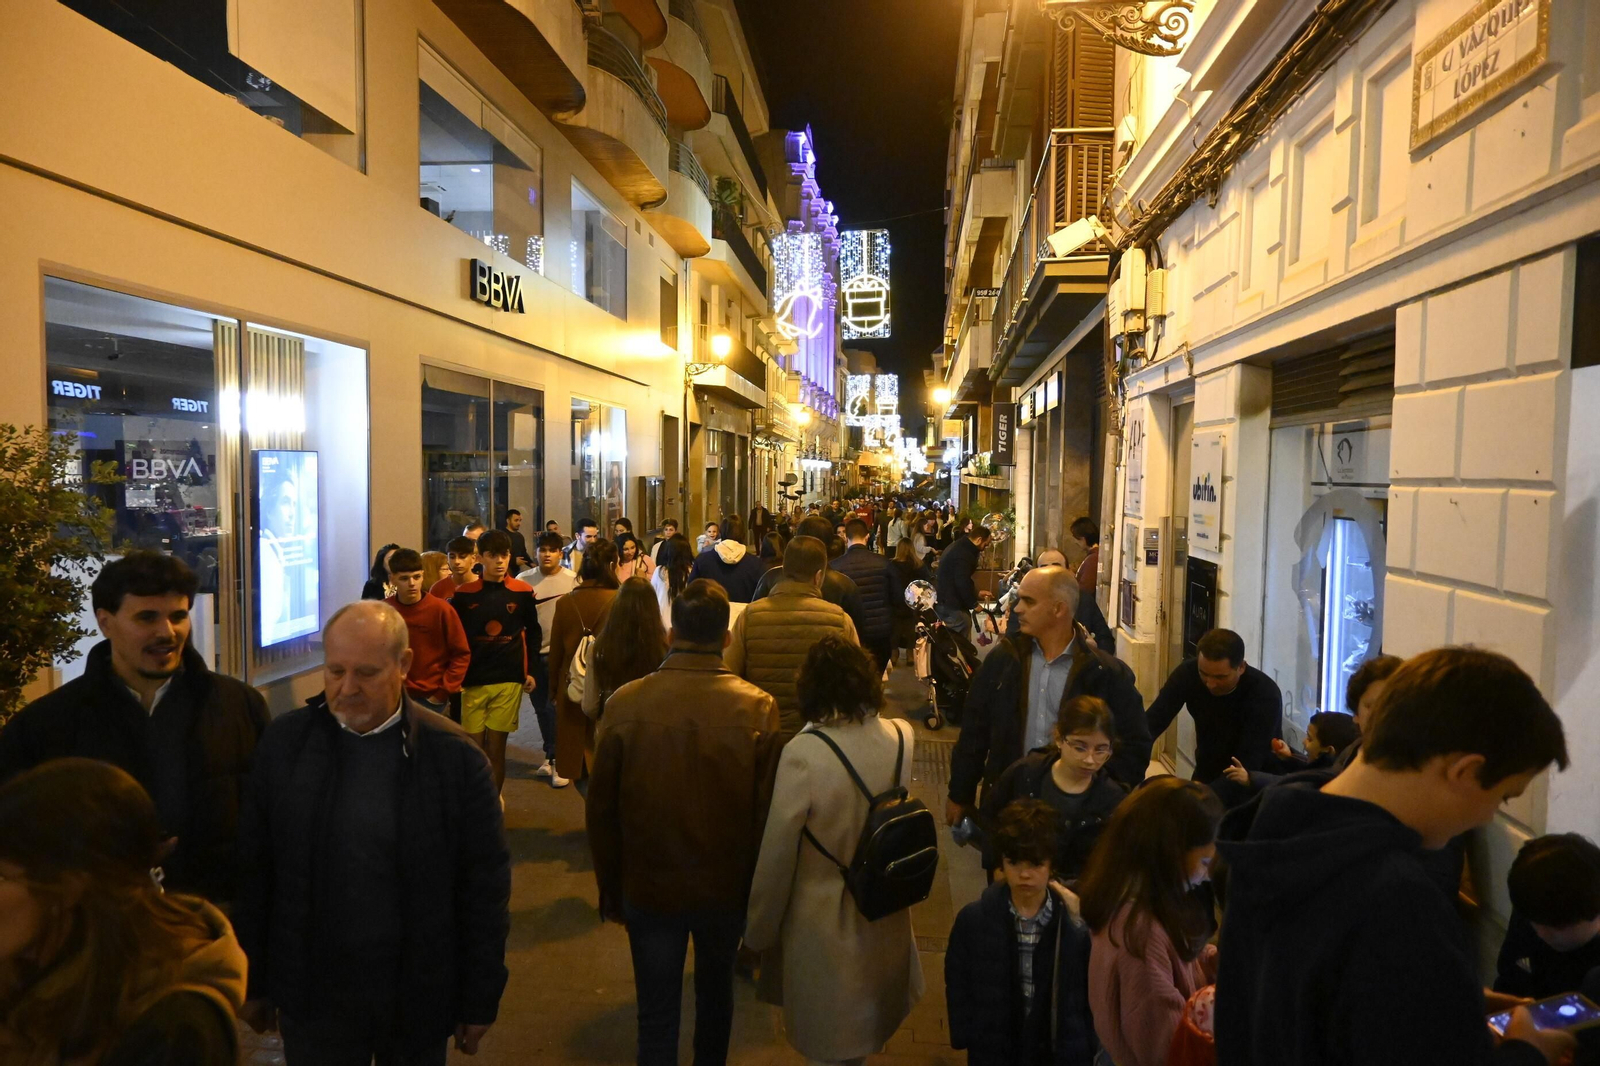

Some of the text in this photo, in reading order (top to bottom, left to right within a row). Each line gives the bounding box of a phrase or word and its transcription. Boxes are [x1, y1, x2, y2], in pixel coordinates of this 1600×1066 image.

[1442, 47, 1454, 72] C/
[1453, 48, 1500, 99] LÓPEZ
[470, 258, 525, 314] BBVA
[998, 414, 1008, 453] TIGER
[132, 456, 203, 480] BBVA
